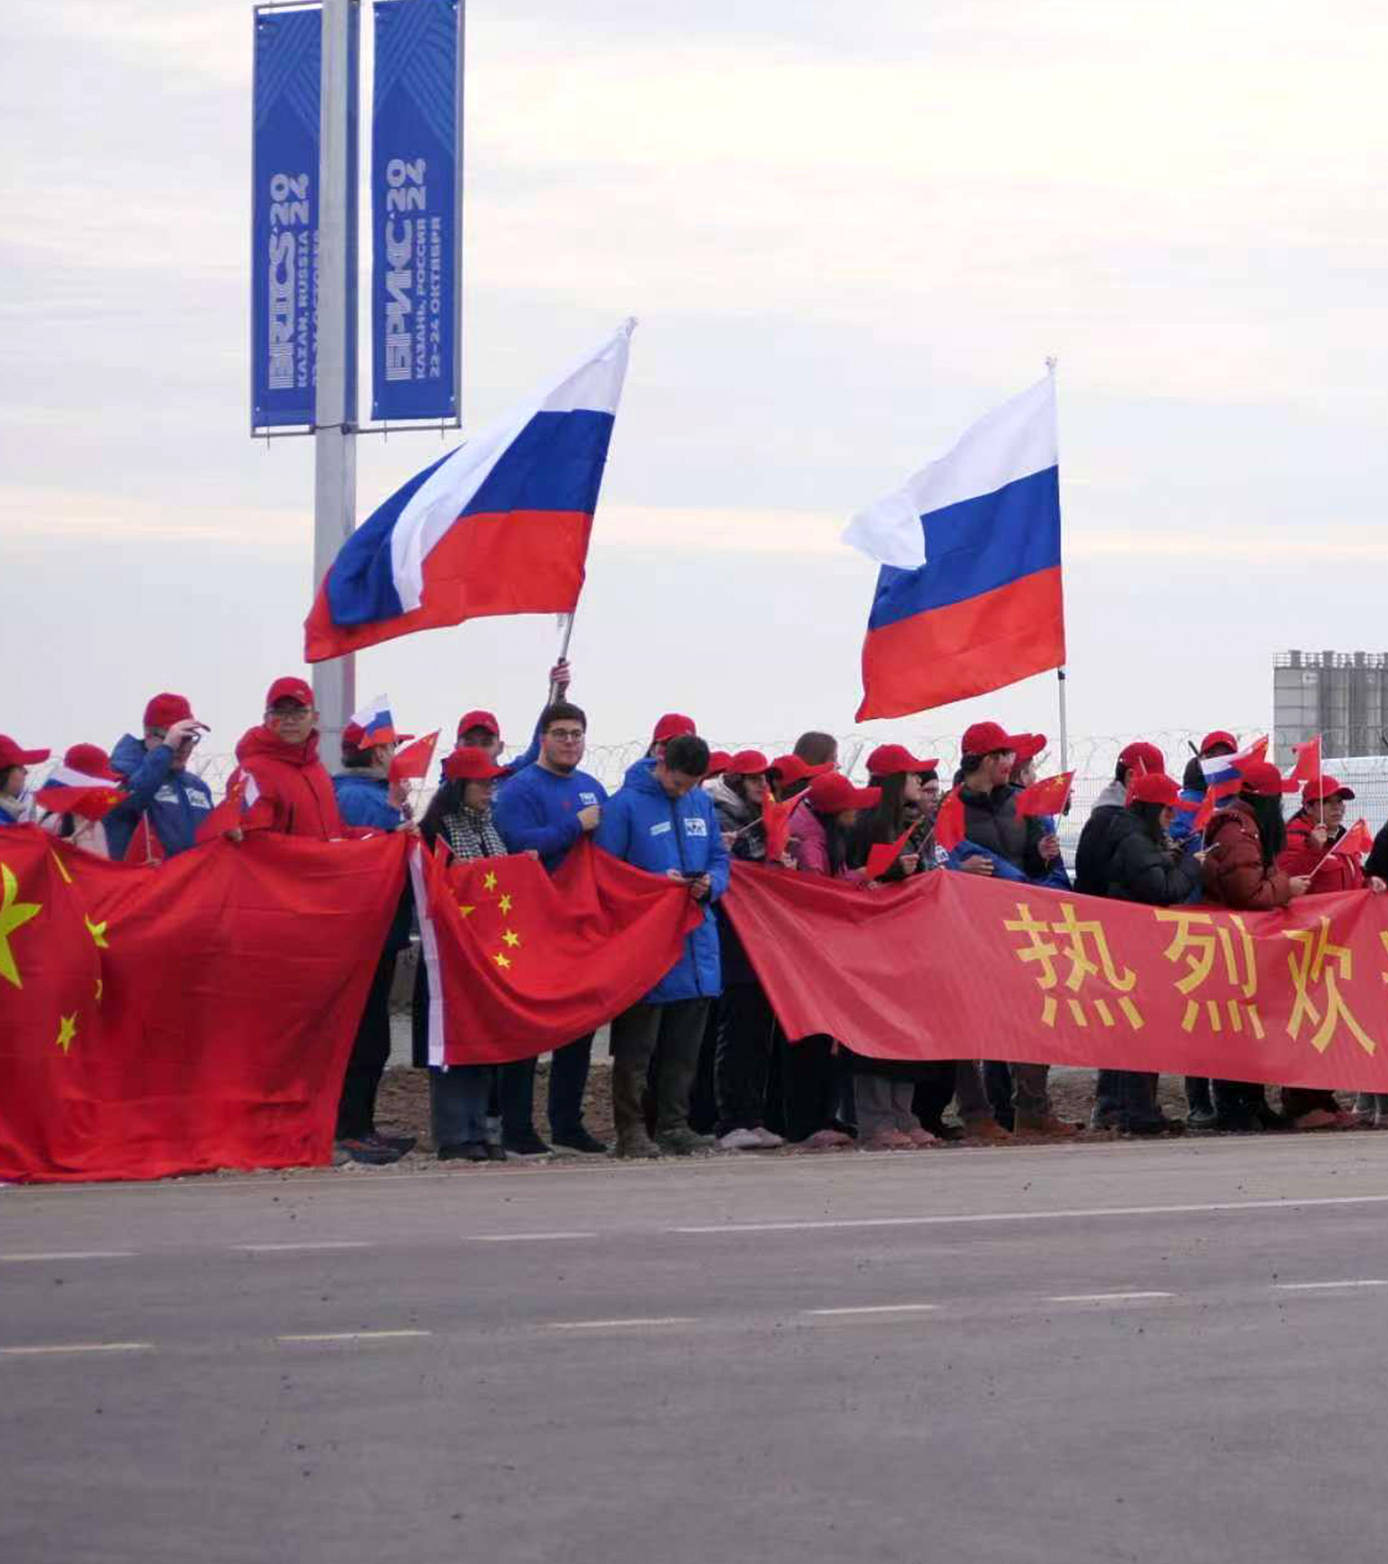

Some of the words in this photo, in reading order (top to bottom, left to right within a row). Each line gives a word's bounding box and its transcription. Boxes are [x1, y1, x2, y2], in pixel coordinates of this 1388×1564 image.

[297, 231, 309, 307] RUSSIA
[385, 220, 412, 381] БРИС
[416, 218, 427, 296] РОССИЯ
[430, 217, 441, 314] ОКТЯБРЯ
[268, 232, 295, 389] BRICS
